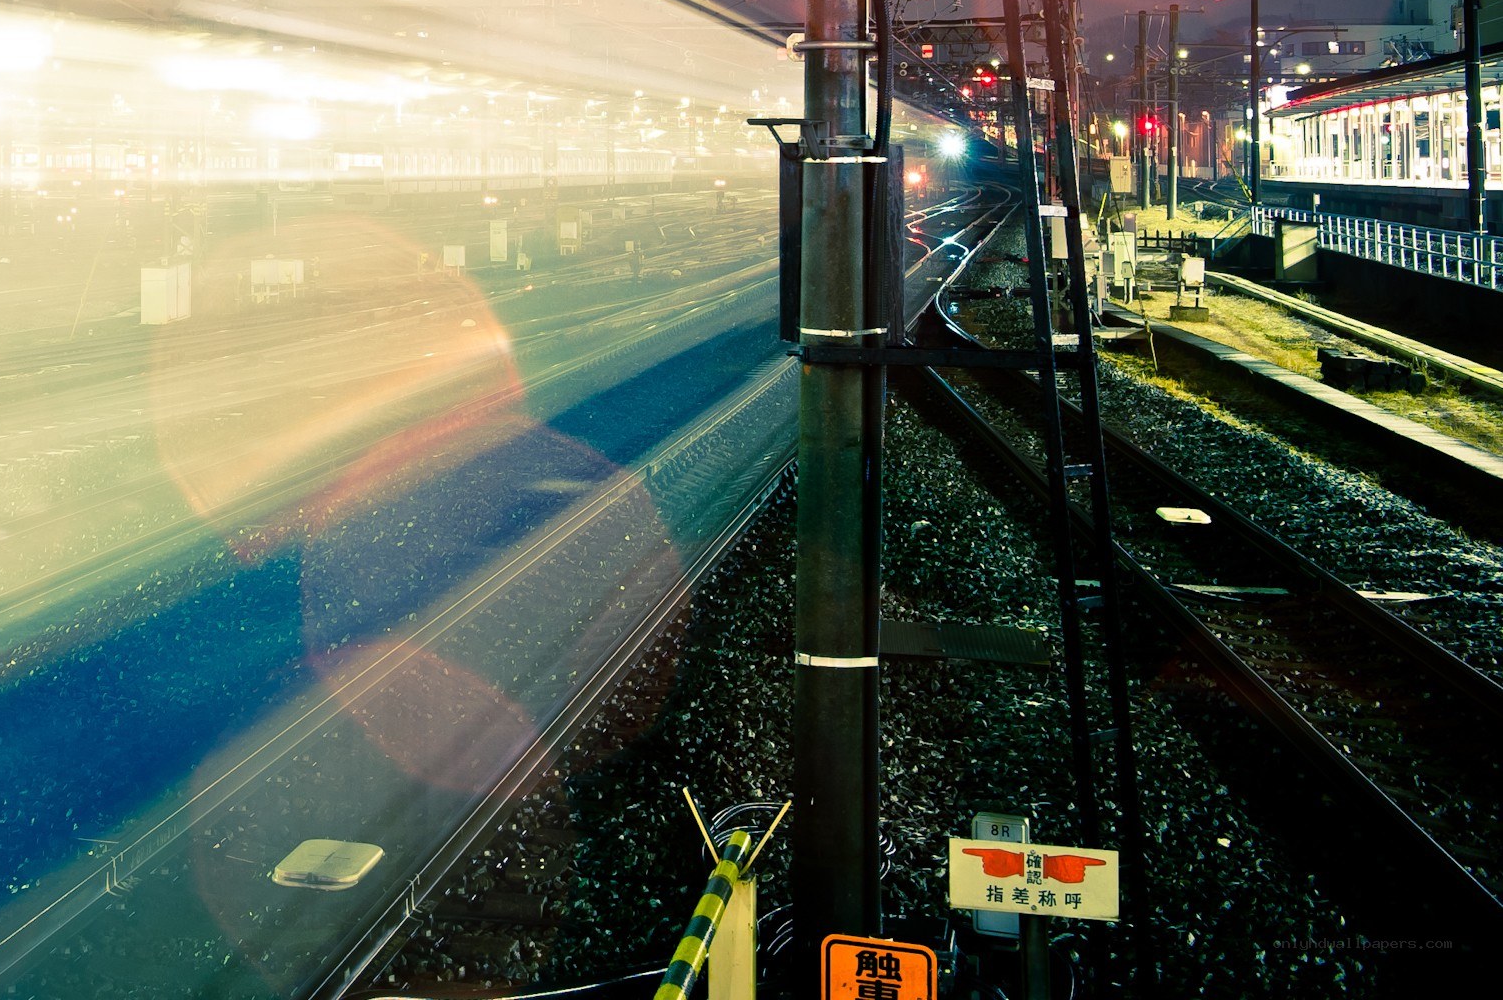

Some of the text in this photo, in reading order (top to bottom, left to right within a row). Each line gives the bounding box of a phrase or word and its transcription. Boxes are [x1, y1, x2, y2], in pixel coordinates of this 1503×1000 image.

[990, 824, 1010, 838] 8R
[1025, 853, 1043, 886] 確認
[985, 884, 1082, 910] 指差称呼
